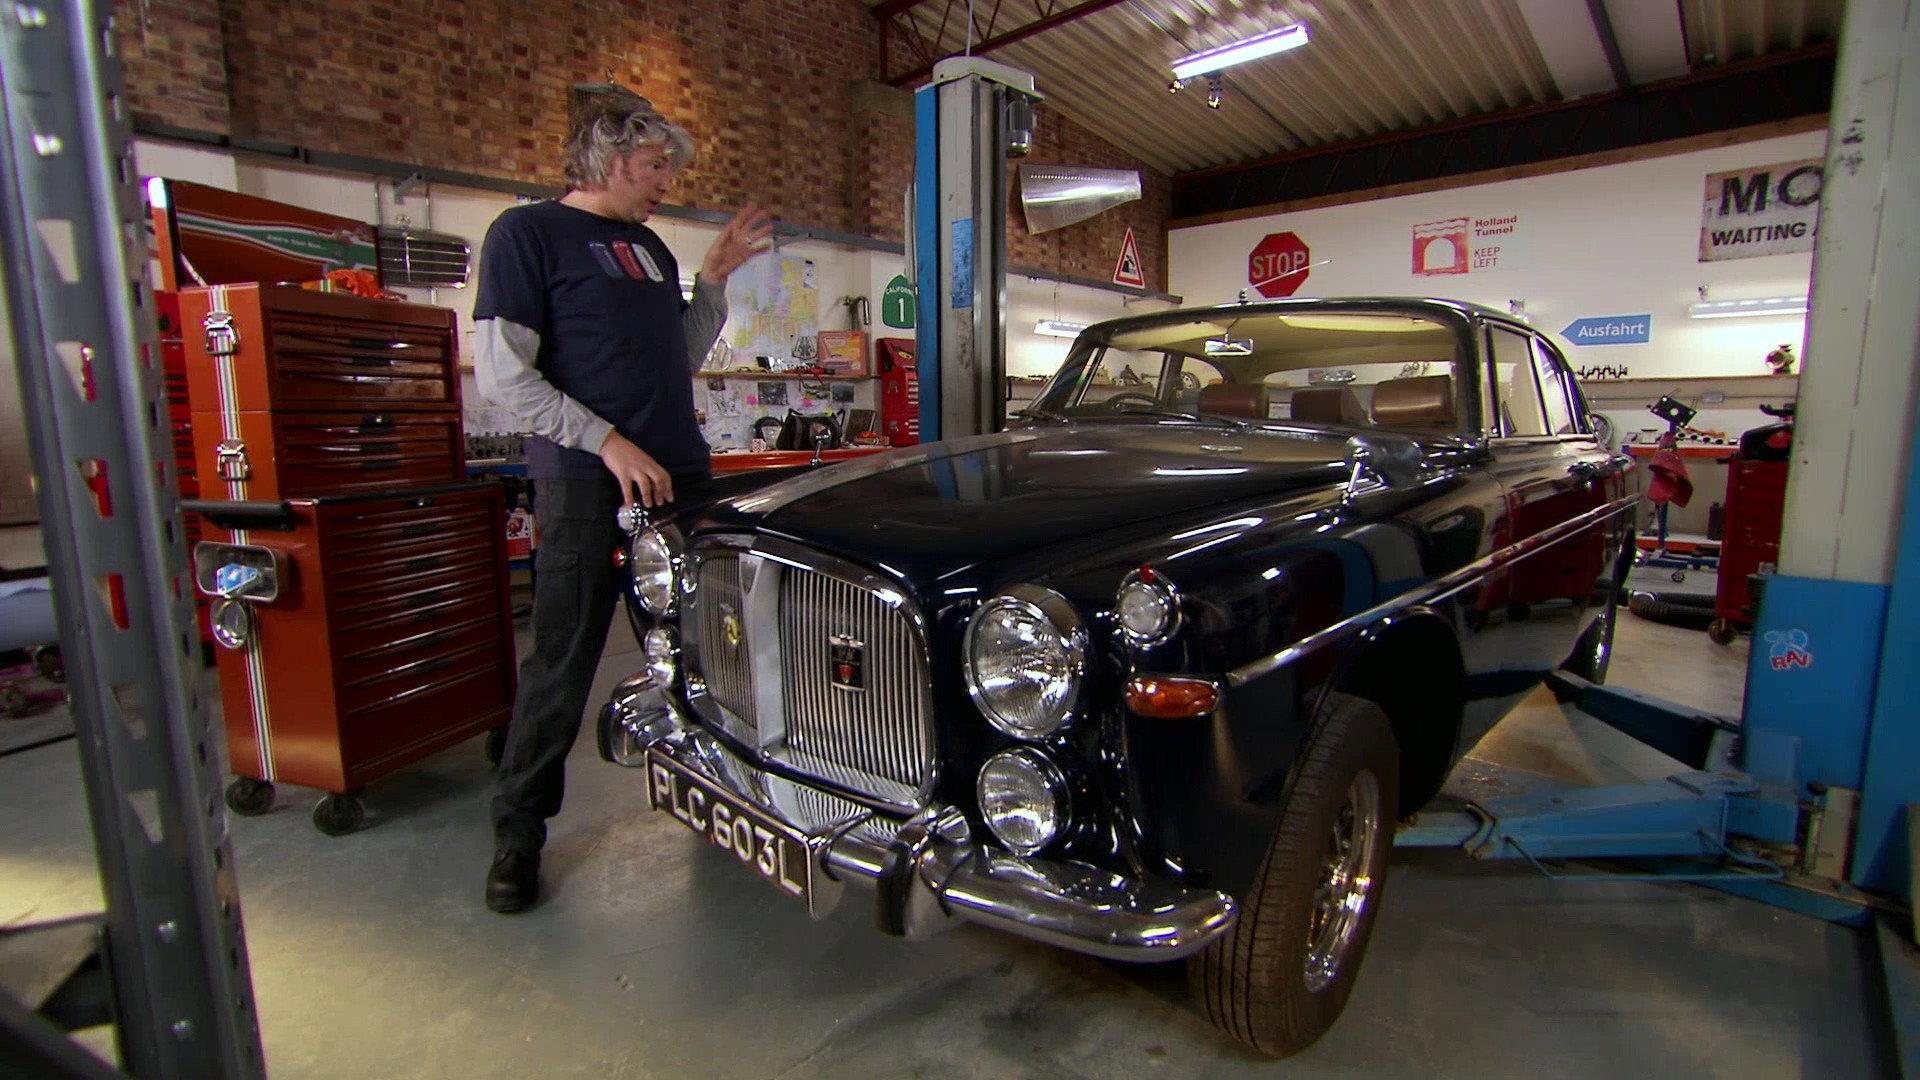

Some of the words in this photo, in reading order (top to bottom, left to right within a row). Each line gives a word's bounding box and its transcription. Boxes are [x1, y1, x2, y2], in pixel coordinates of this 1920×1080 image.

[1475, 215, 1518, 228] Holland
[1475, 225, 1514, 237] Tunnel
[1711, 221, 1807, 247] WAITING
[1473, 246, 1501, 258] KEEP
[1252, 250, 1307, 280] STOP
[1473, 257, 1498, 269] LEFT
[898, 297, 905, 323] 1
[1578, 322, 1645, 338] Ausfahrt
[652, 763, 707, 833] PLC
[711, 801, 803, 896] 603L
